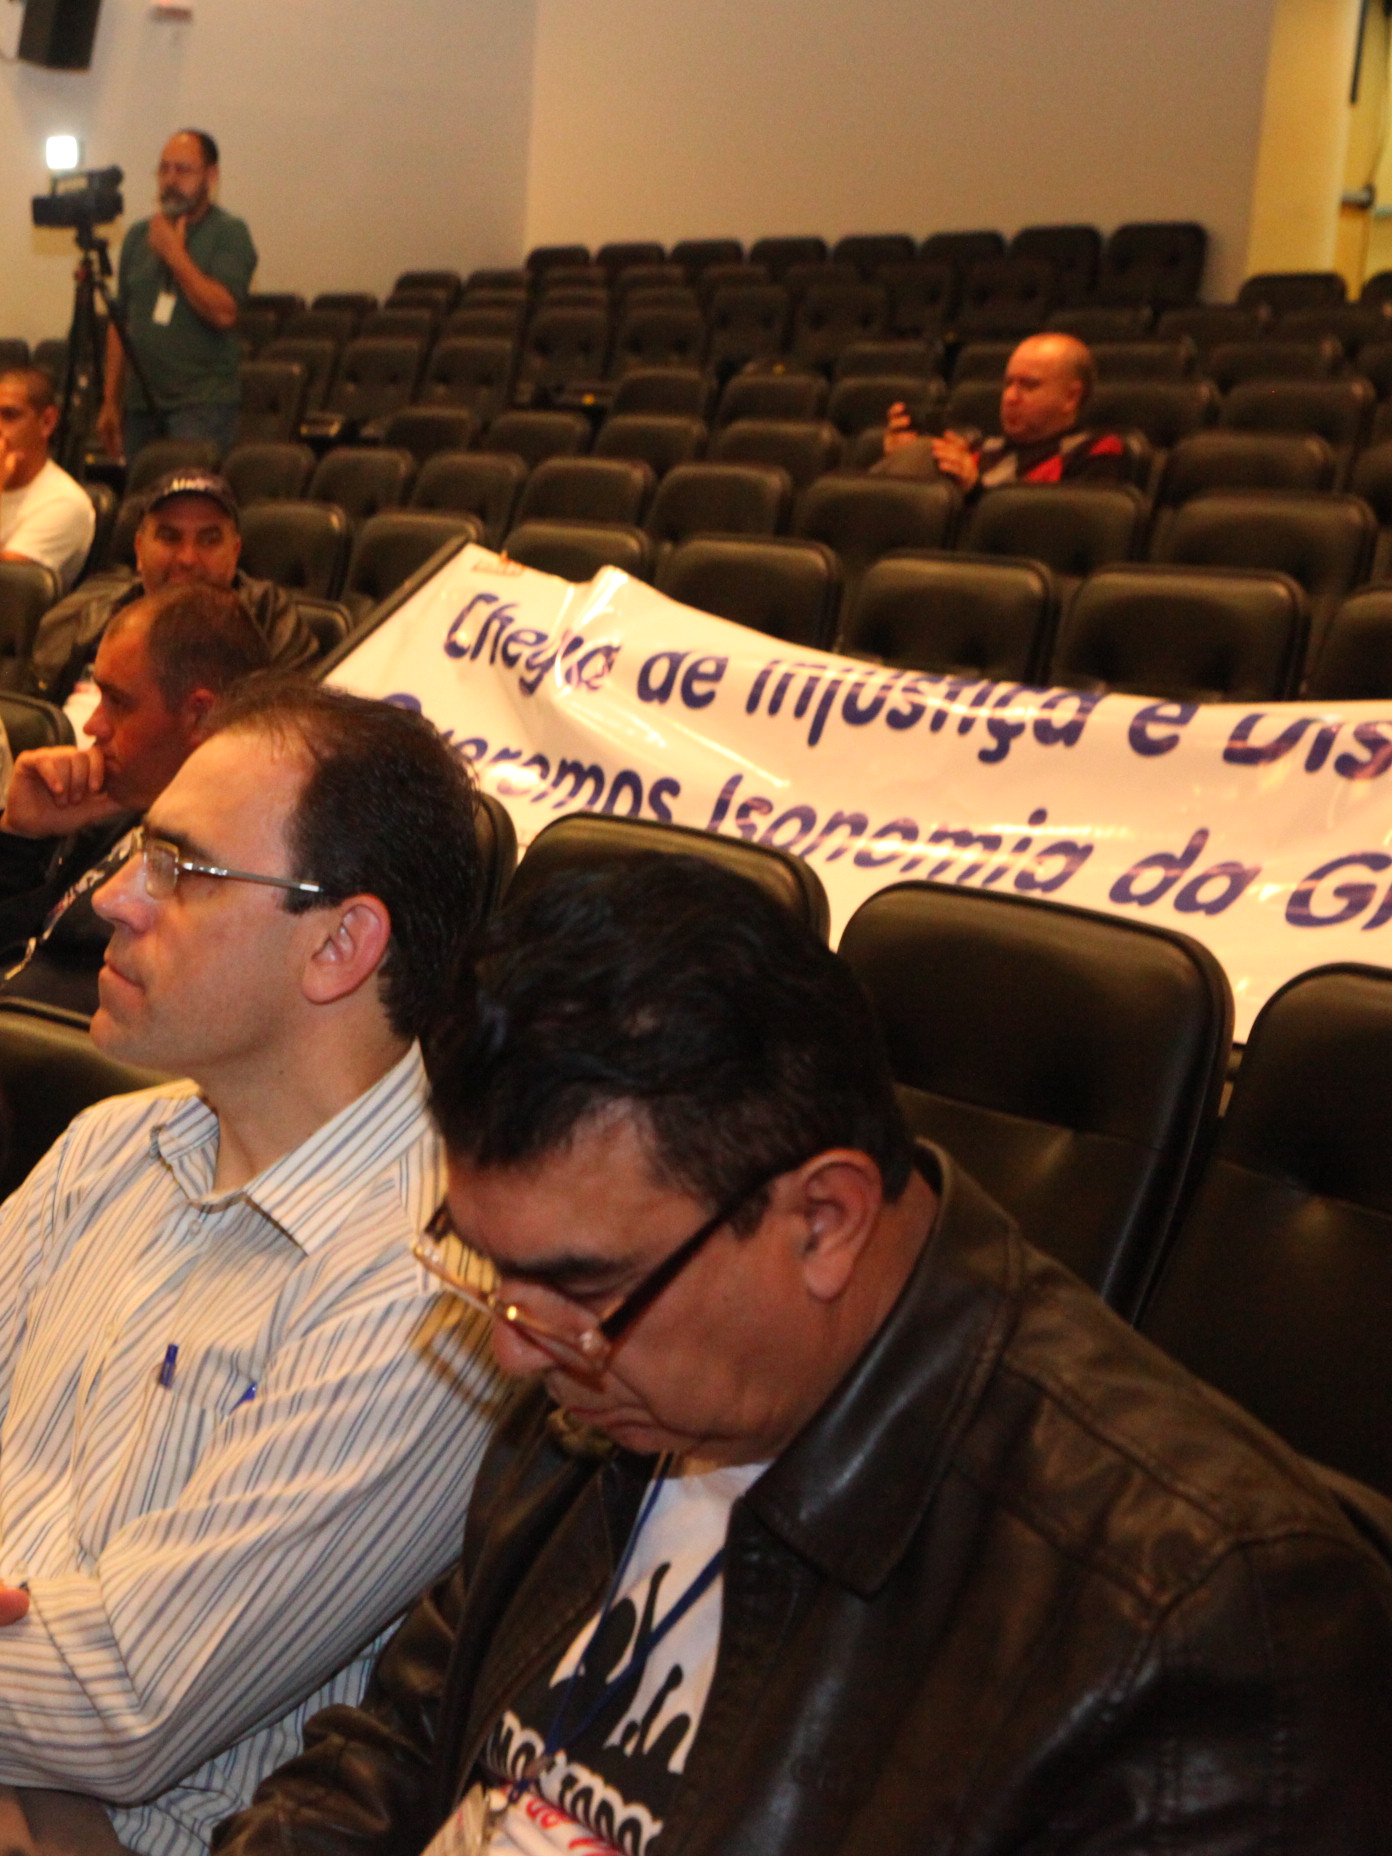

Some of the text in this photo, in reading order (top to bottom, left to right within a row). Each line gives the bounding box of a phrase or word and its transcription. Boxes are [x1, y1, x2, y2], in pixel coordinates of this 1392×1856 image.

[1127, 701, 1200, 757] e
[708, 773, 1095, 893] Isonomia
[1109, 828, 1262, 916] da
